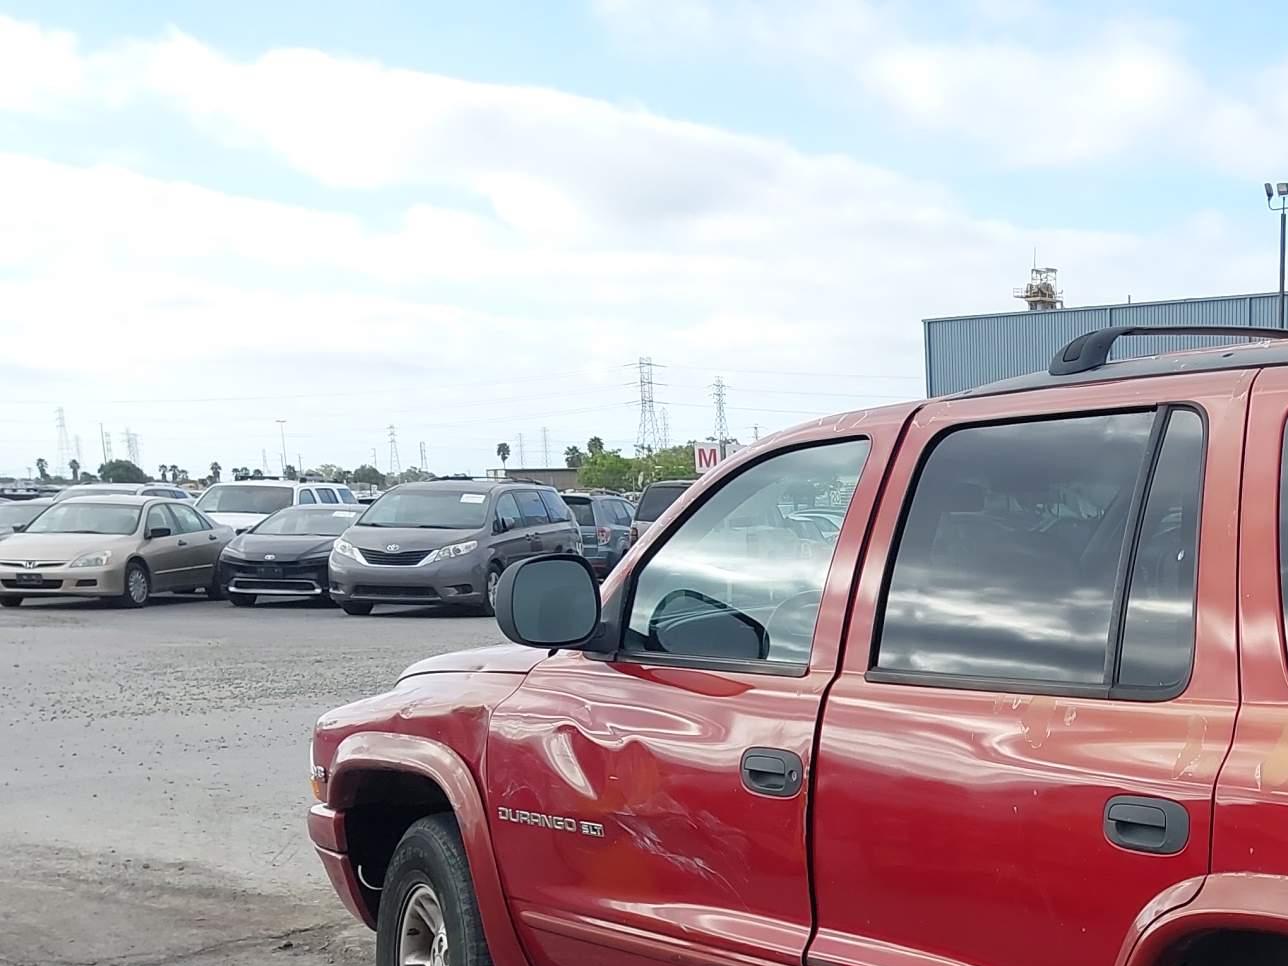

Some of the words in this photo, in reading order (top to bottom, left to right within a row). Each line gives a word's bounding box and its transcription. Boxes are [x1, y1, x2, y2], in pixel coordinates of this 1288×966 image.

[698, 448, 718, 468] M
[498, 807, 577, 832] DURANGO
[580, 821, 604, 838] SLT
